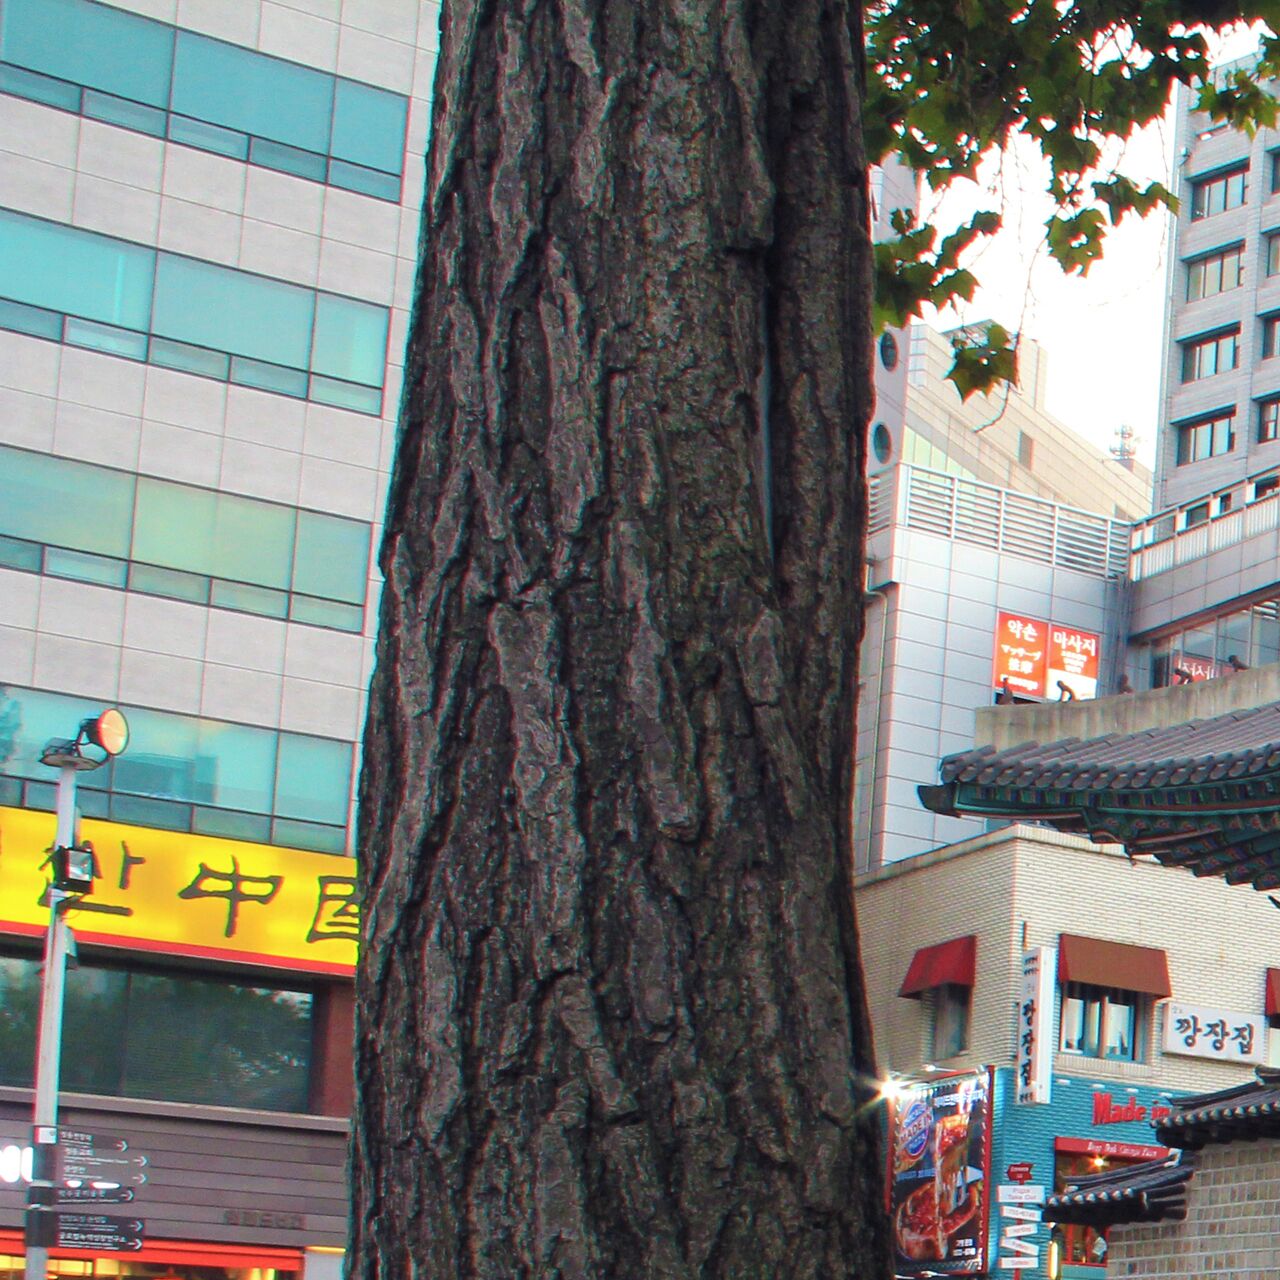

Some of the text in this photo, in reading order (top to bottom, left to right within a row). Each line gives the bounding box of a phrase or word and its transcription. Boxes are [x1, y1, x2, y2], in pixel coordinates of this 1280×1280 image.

[1053, 631, 1096, 657] 마사지
[1175, 1015, 1255, 1055] 깡장집
[1092, 1091, 1171, 1126] Made in
